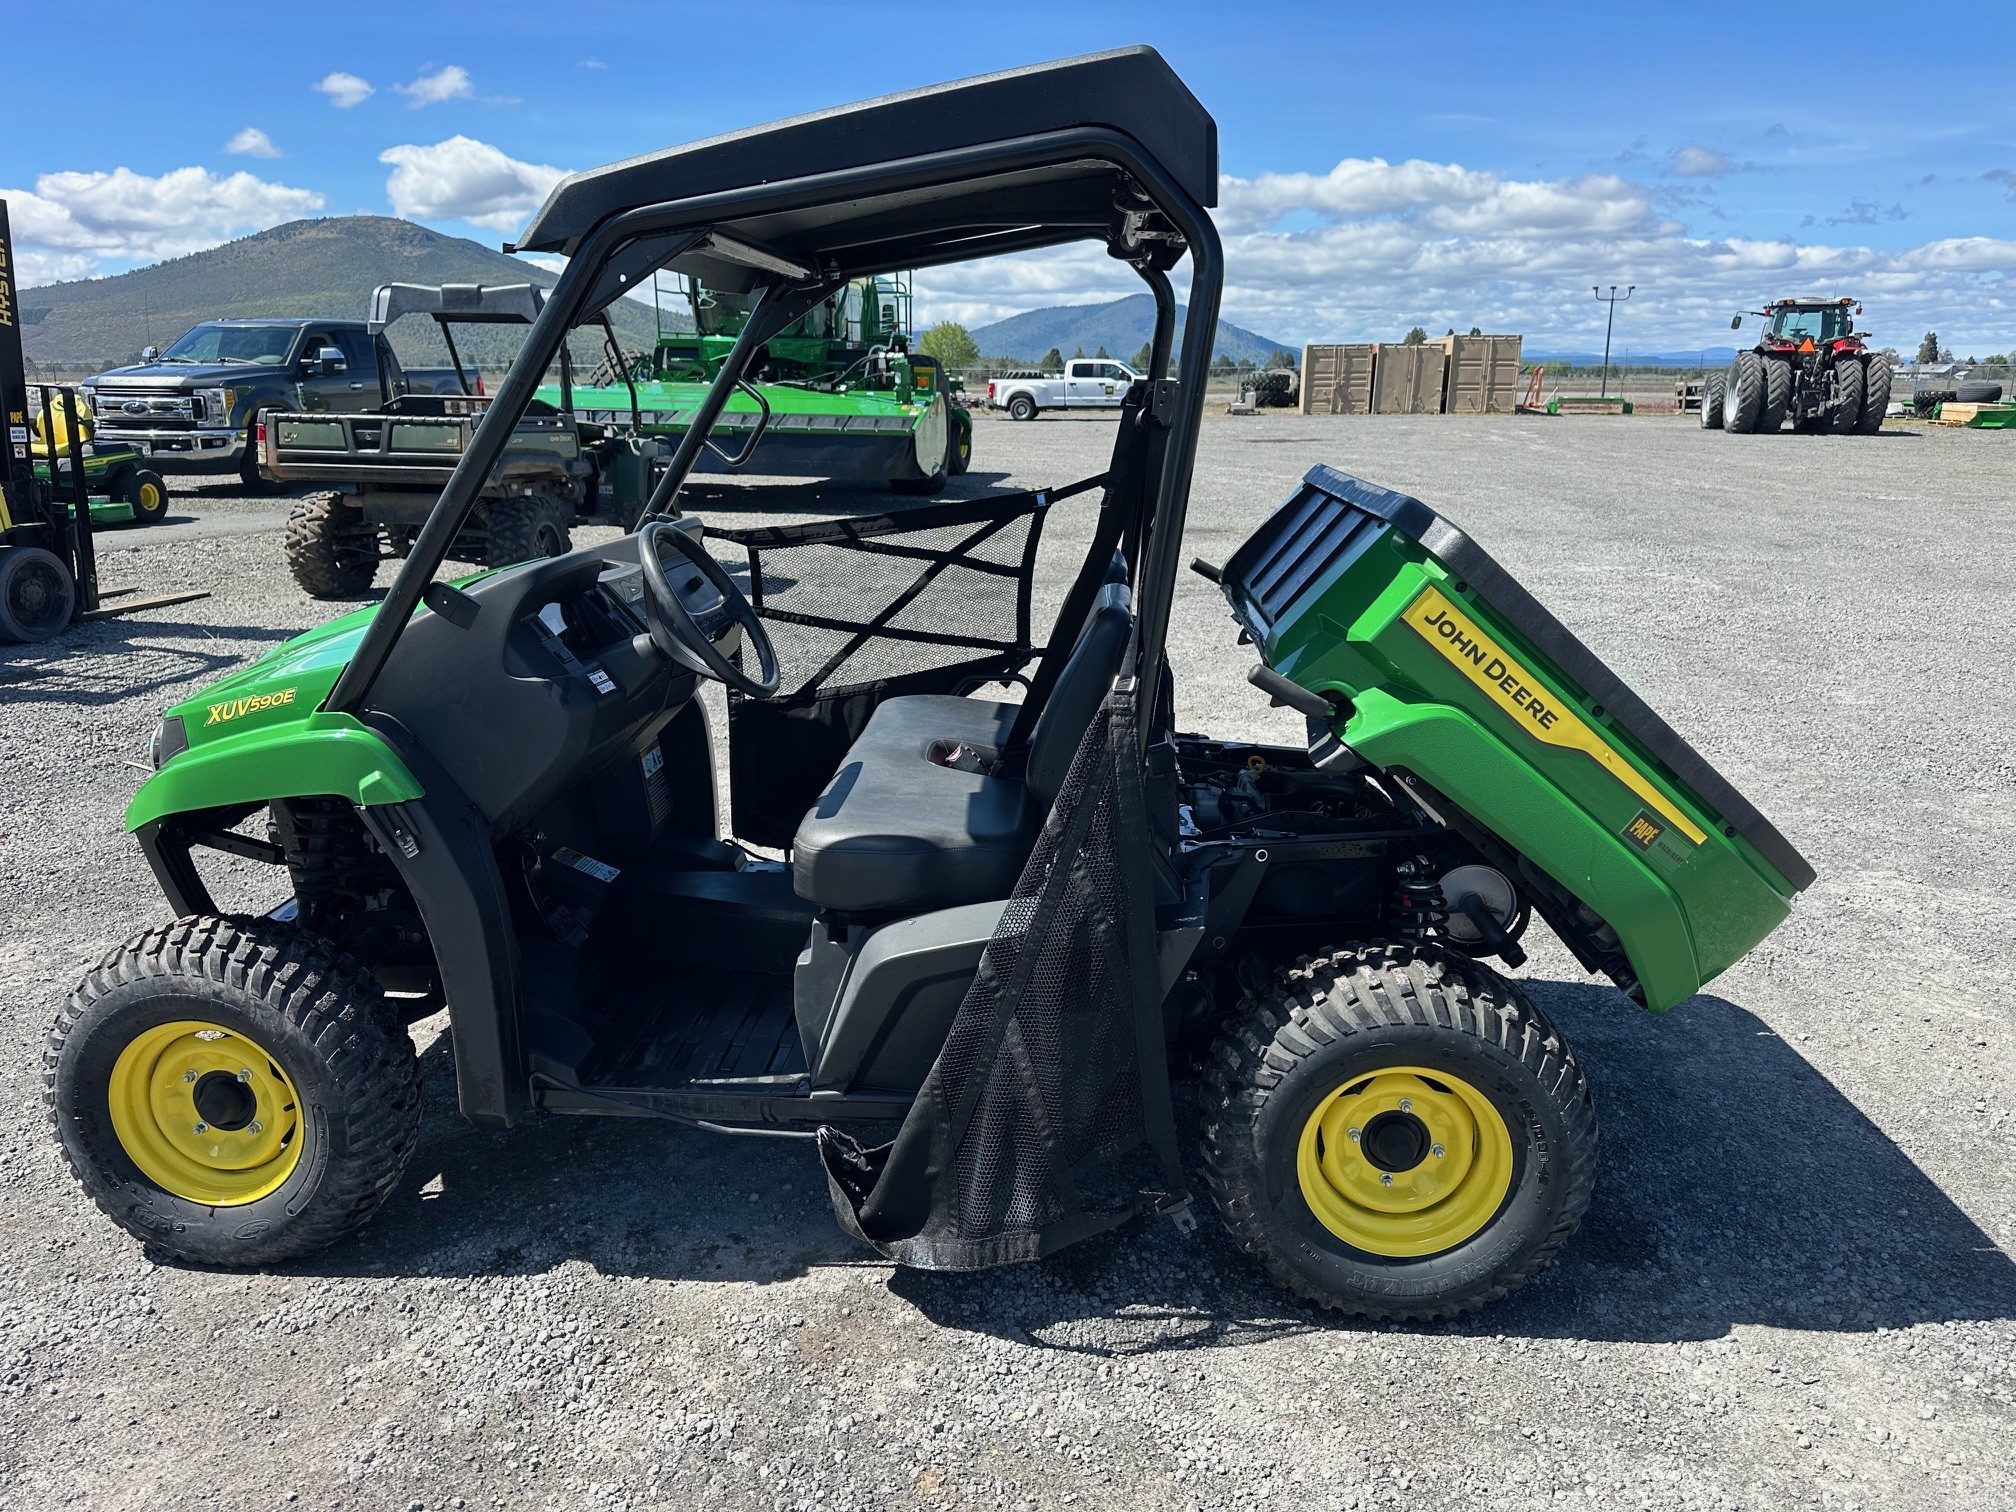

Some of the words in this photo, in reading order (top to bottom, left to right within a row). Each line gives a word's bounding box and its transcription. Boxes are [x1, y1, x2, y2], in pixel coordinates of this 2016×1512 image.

[206, 688, 296, 725] XUV590E
[1423, 610, 1487, 666] JOHN
[1483, 658, 1559, 730] DEERE
